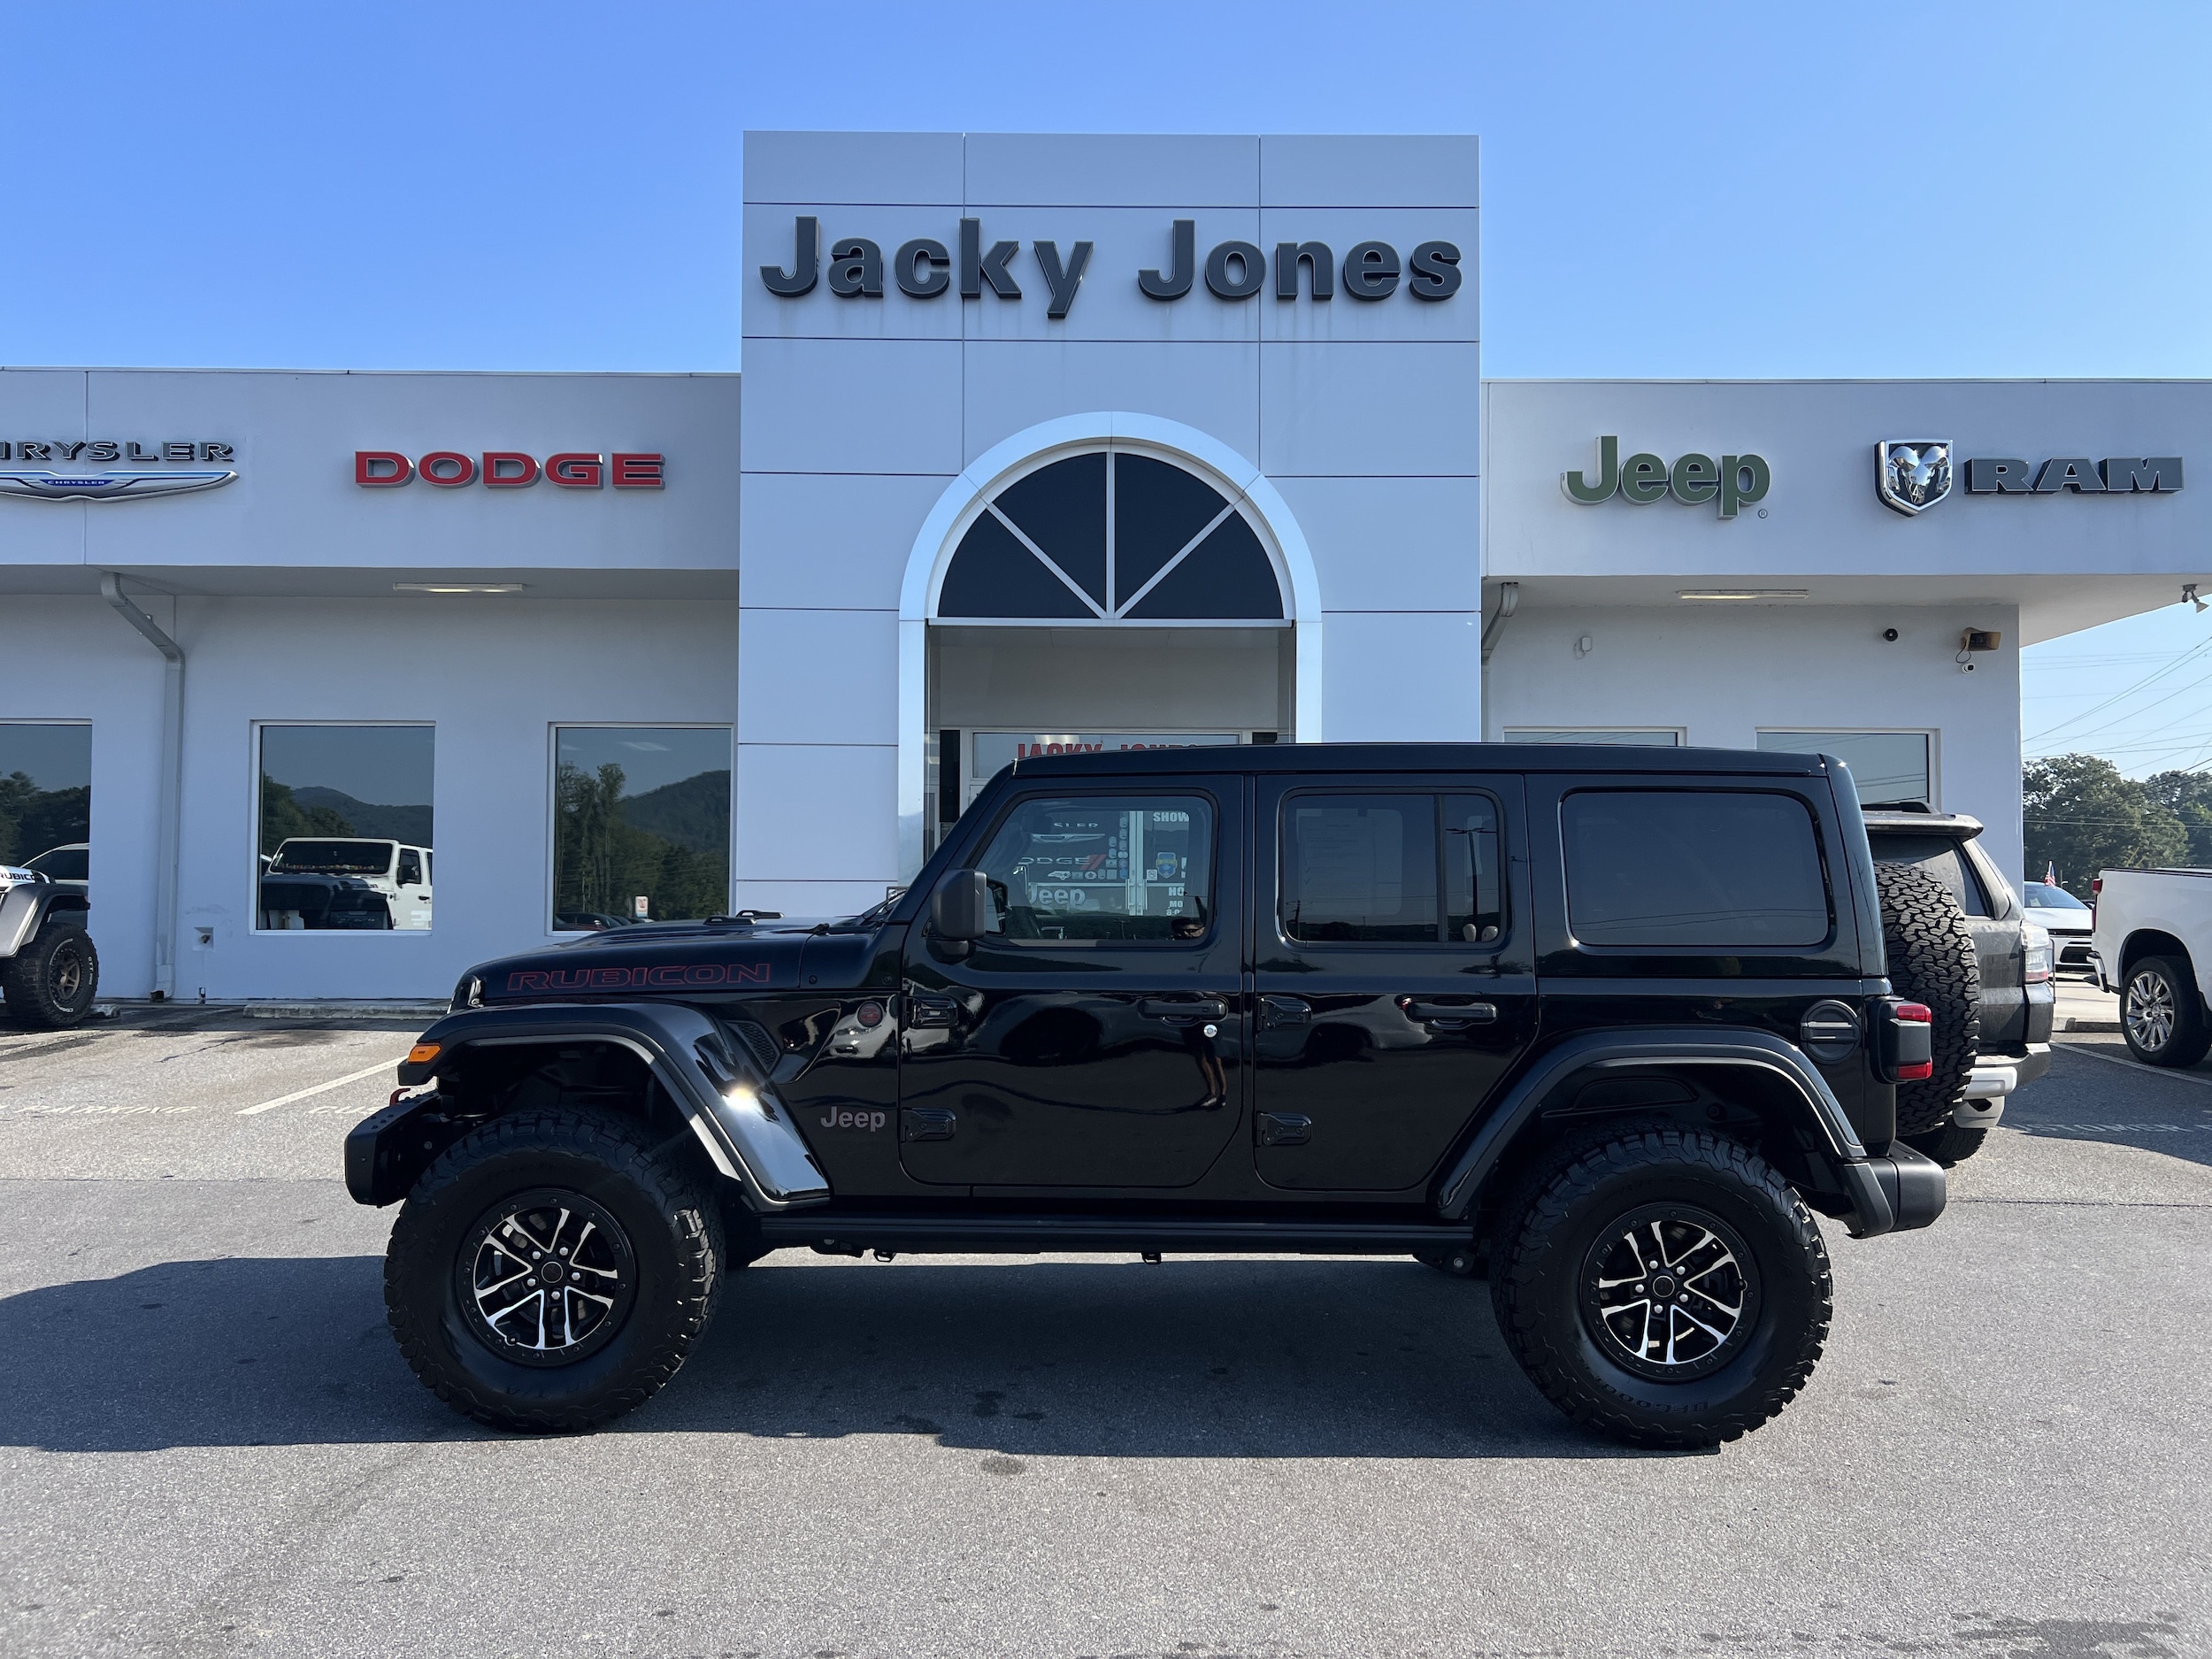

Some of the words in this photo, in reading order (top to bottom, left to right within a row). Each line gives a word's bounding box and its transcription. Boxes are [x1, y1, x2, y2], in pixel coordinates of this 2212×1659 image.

[759, 216, 1094, 319] Jacky
[1138, 219, 1462, 302] Jones
[0, 440, 234, 462] RYSLER
[355, 451, 665, 489] DODGE
[1561, 435, 1770, 520] Jeep
[1964, 457, 2185, 495] RAM
[1028, 883, 1086, 911] Jeep
[507, 964, 771, 991] RUBICON
[820, 1106, 886, 1133] Jeep
